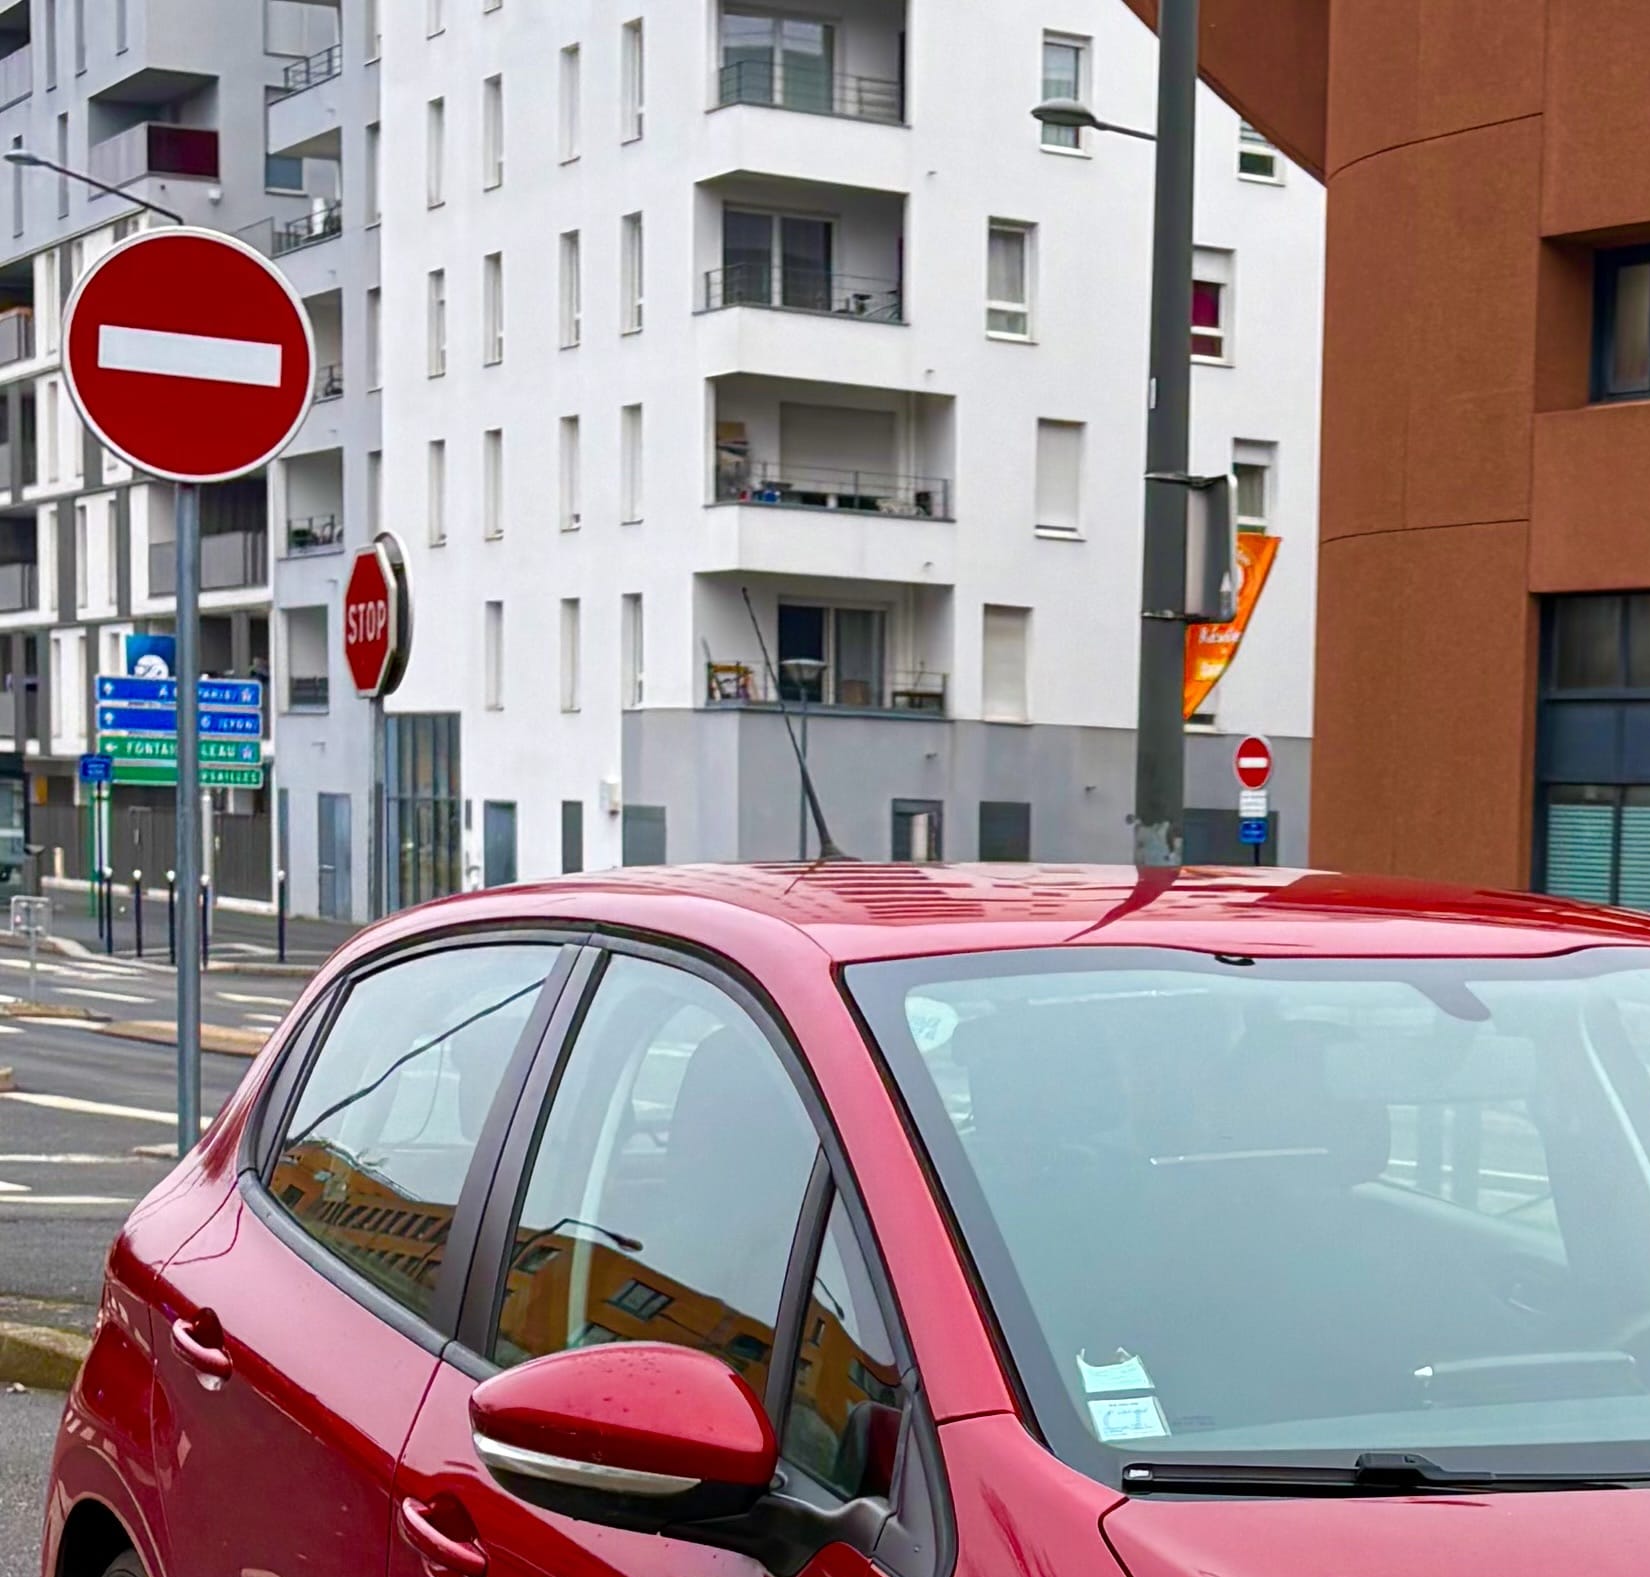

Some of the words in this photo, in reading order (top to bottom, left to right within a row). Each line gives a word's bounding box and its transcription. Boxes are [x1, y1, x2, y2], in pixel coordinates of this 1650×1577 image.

[348, 600, 386, 645] STOP
[126, 741, 236, 757] FONTAILEAU
[200, 771, 257, 783] RSAILLES
